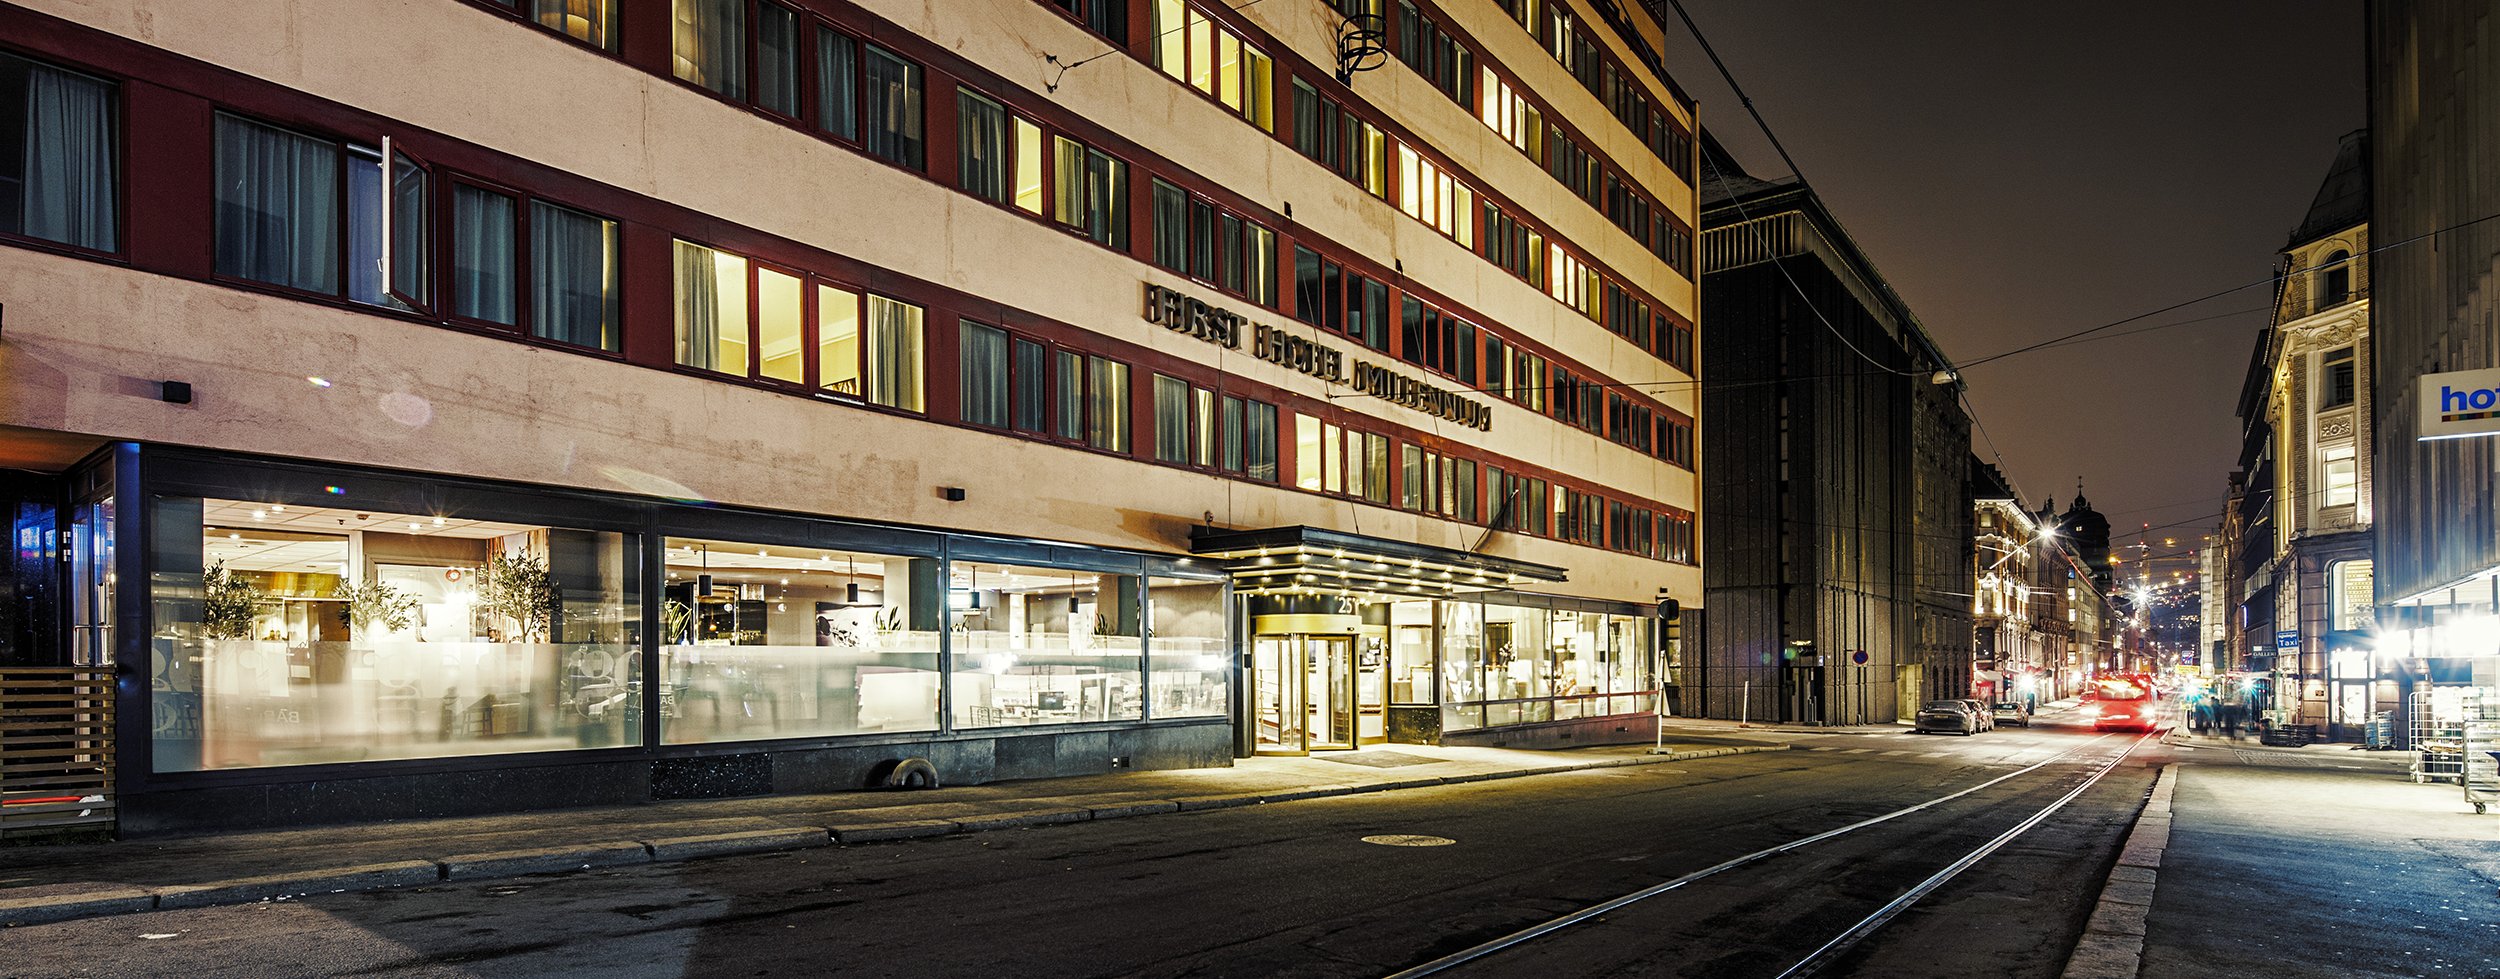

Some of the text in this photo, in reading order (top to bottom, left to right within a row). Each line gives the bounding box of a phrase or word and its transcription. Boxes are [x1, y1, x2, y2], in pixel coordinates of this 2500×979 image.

[1148, 285, 1492, 432] FIRST HOTEL MILLENNIUM
[2441, 385, 2500, 412] ho
[1338, 597, 1352, 613] 25
[2279, 639, 2298, 647] Taxi
